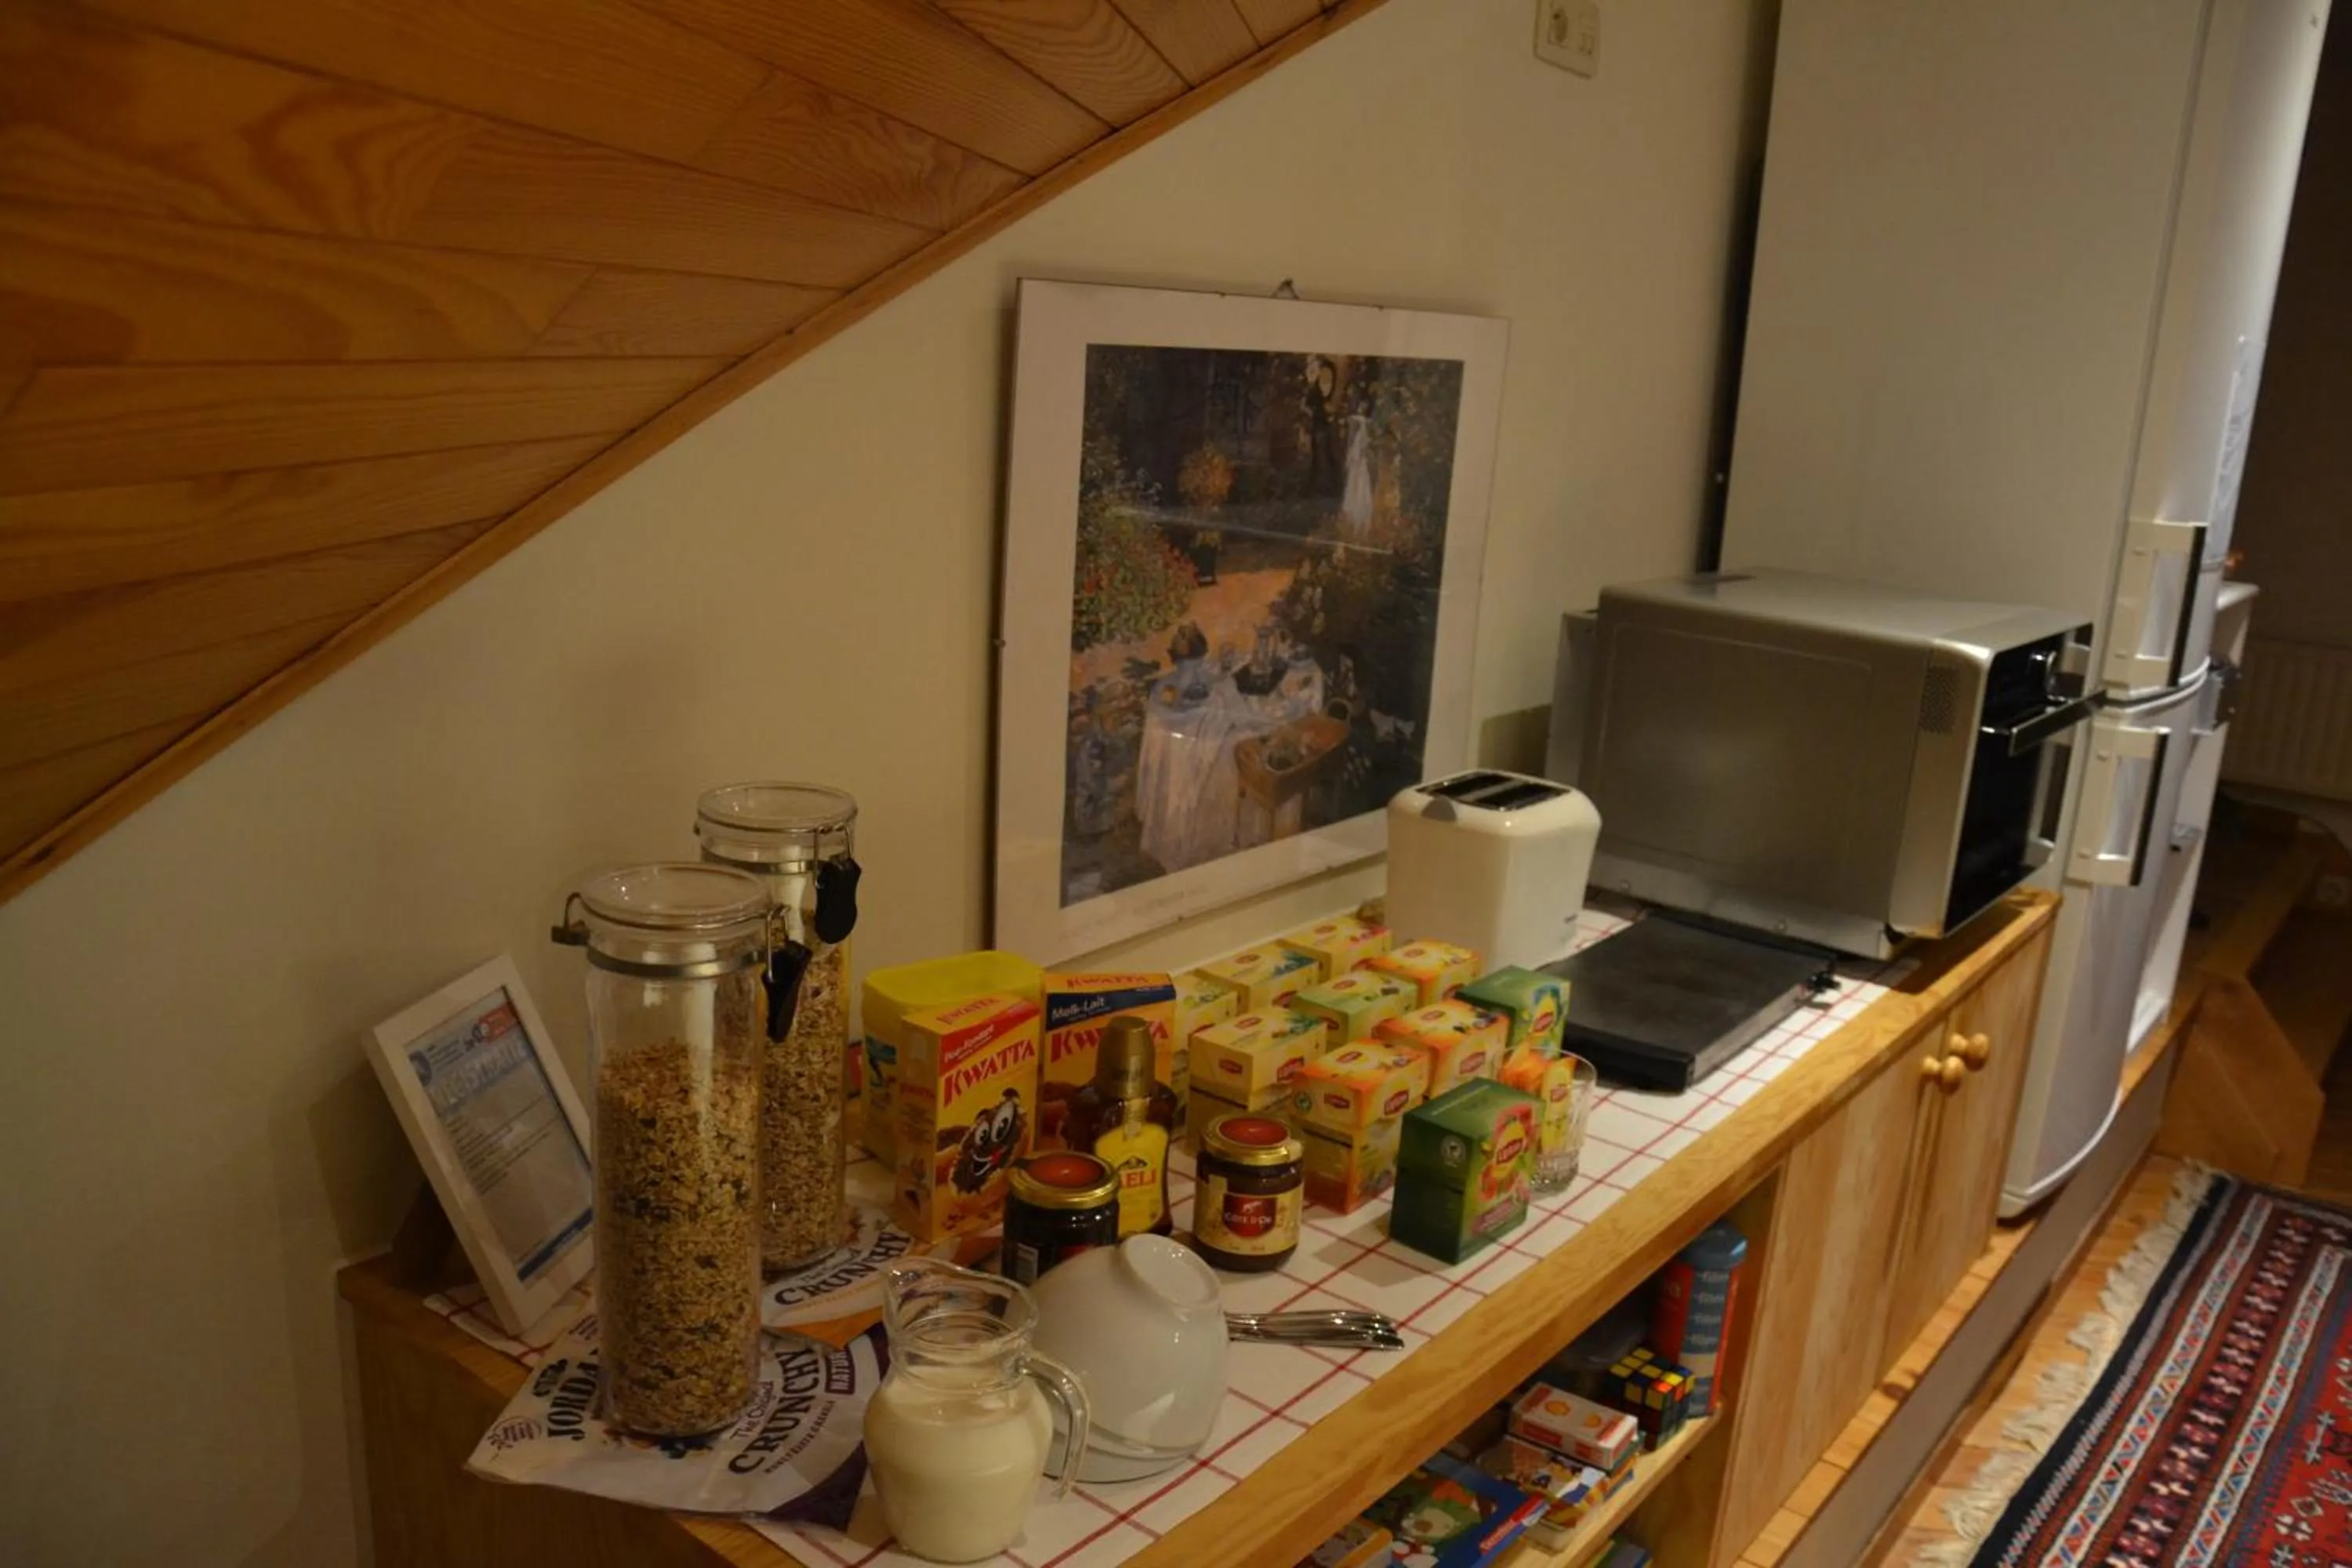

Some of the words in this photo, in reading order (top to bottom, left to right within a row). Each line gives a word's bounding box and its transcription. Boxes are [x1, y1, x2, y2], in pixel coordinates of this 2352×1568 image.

[943, 1040, 1036, 1109] KWATTA
[1051, 1020, 1169, 1063] KWA
[1119, 1167, 1156, 1188] ELI
[775, 1231, 912, 1305] CRUNCHY
[547, 1361, 602, 1442] JORDA
[728, 1348, 820, 1474] CRUNCHY
